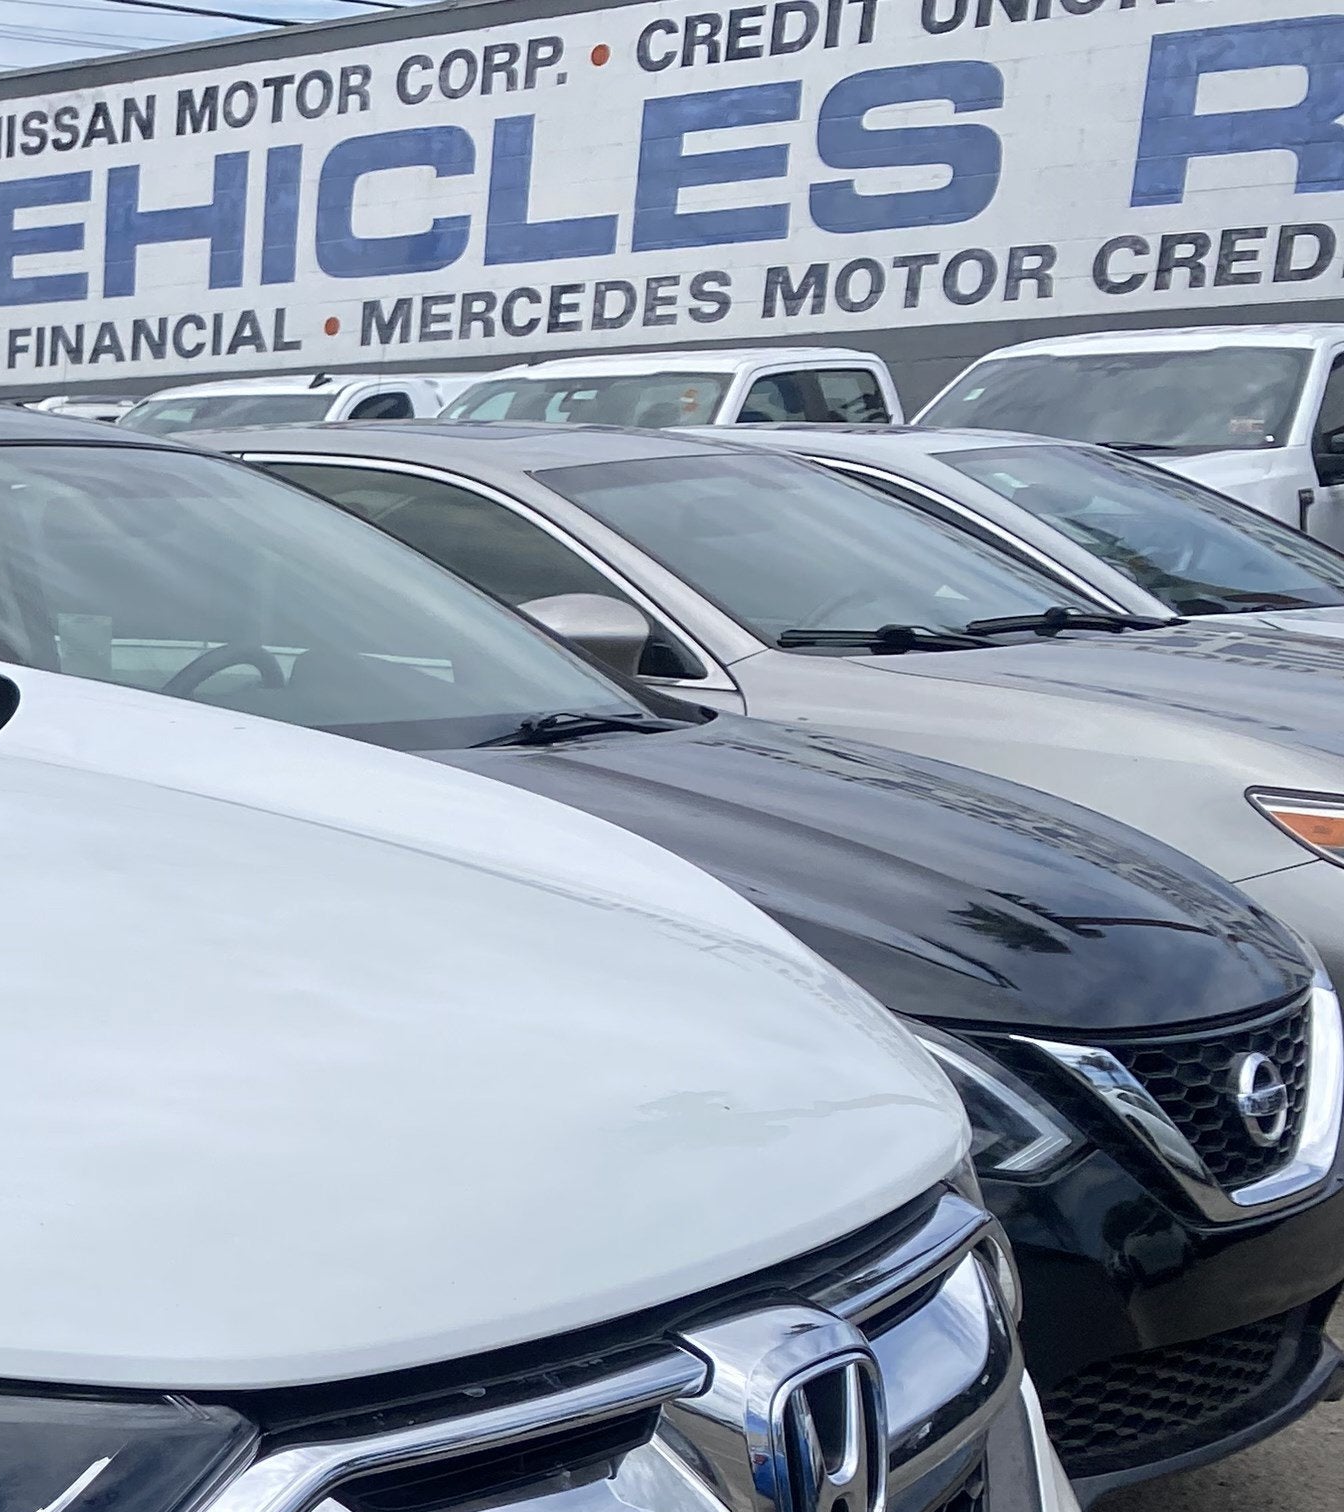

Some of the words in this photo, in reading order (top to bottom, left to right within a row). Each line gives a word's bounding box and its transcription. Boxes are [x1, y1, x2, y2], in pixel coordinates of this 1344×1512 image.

[175, 64, 372, 135] MOTOR
[396, 36, 568, 105] CORP.
[636, 0, 880, 72] CREDIT
[6, 308, 301, 370] FINANCIAL
[360, 270, 731, 347] MERCEDES
[762, 244, 1058, 319] MOTOR
[1093, 222, 1344, 295] CRED
